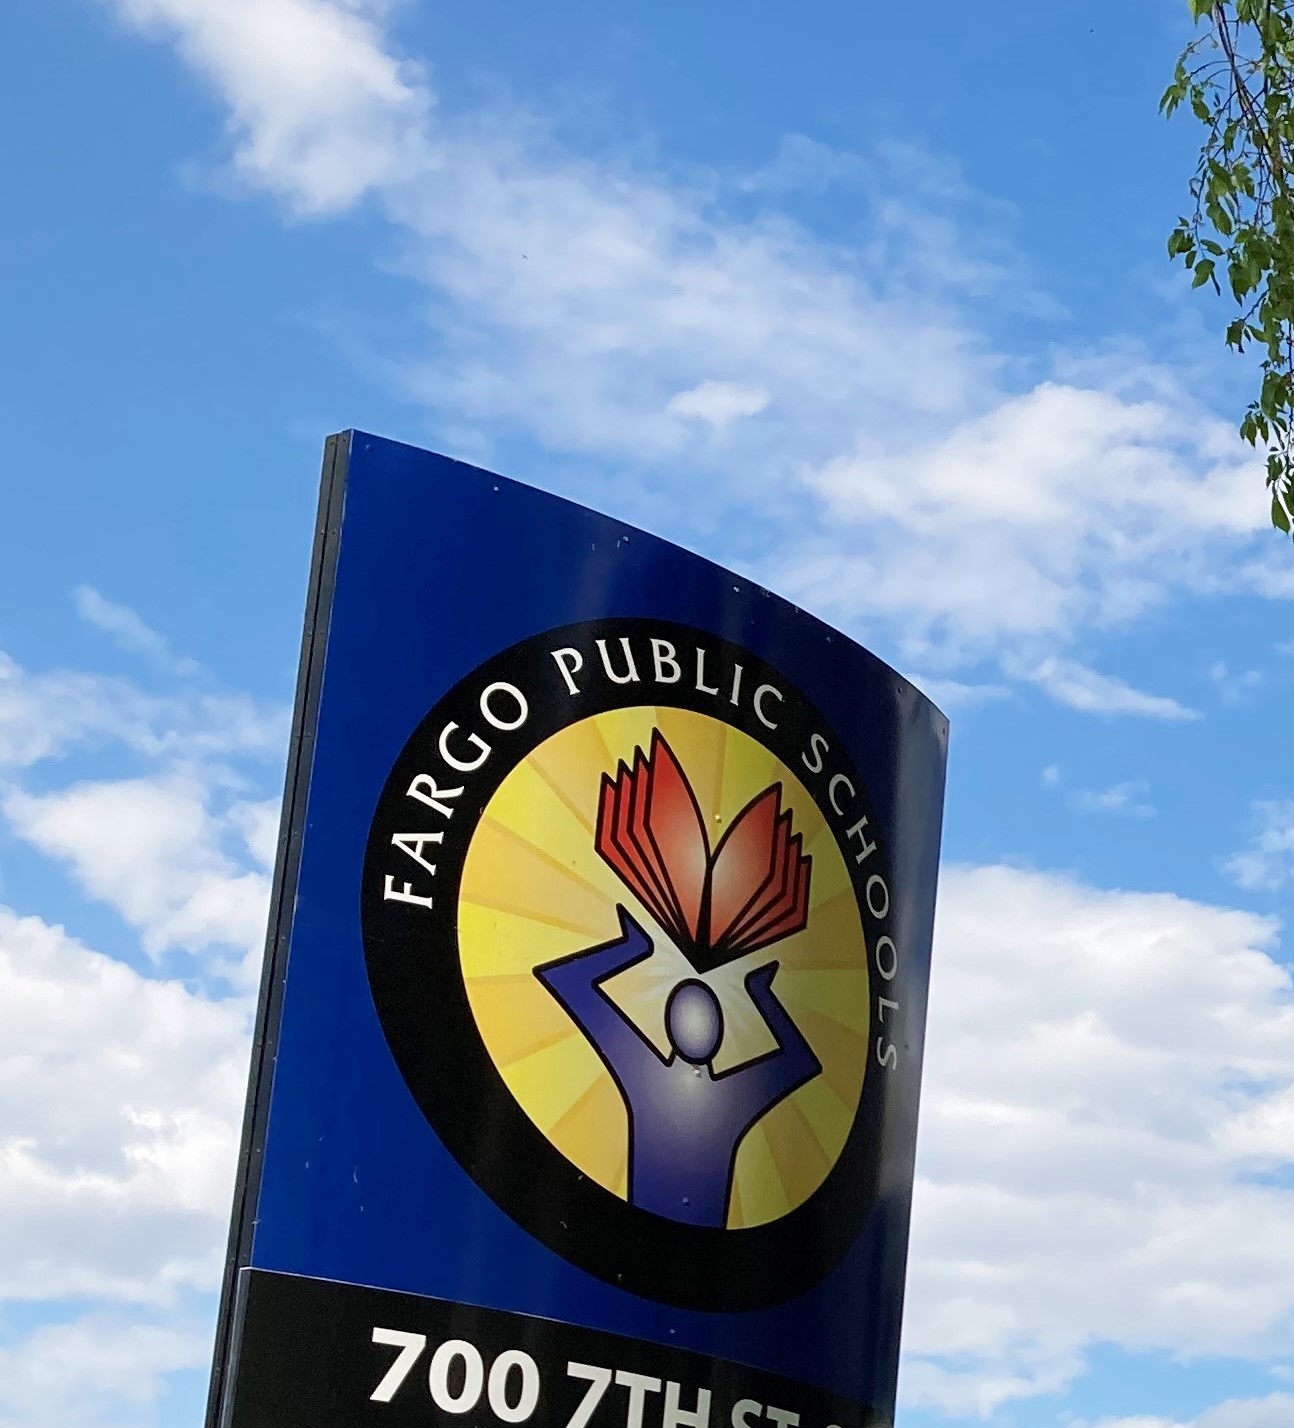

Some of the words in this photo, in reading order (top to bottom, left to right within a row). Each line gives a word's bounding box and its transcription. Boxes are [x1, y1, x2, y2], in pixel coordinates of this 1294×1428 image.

[382, 680, 530, 910] FARGO
[549, 636, 785, 731] PUBLIC
[800, 732, 901, 1072] SCHOOLS
[368, 1326, 542, 1424] 700
